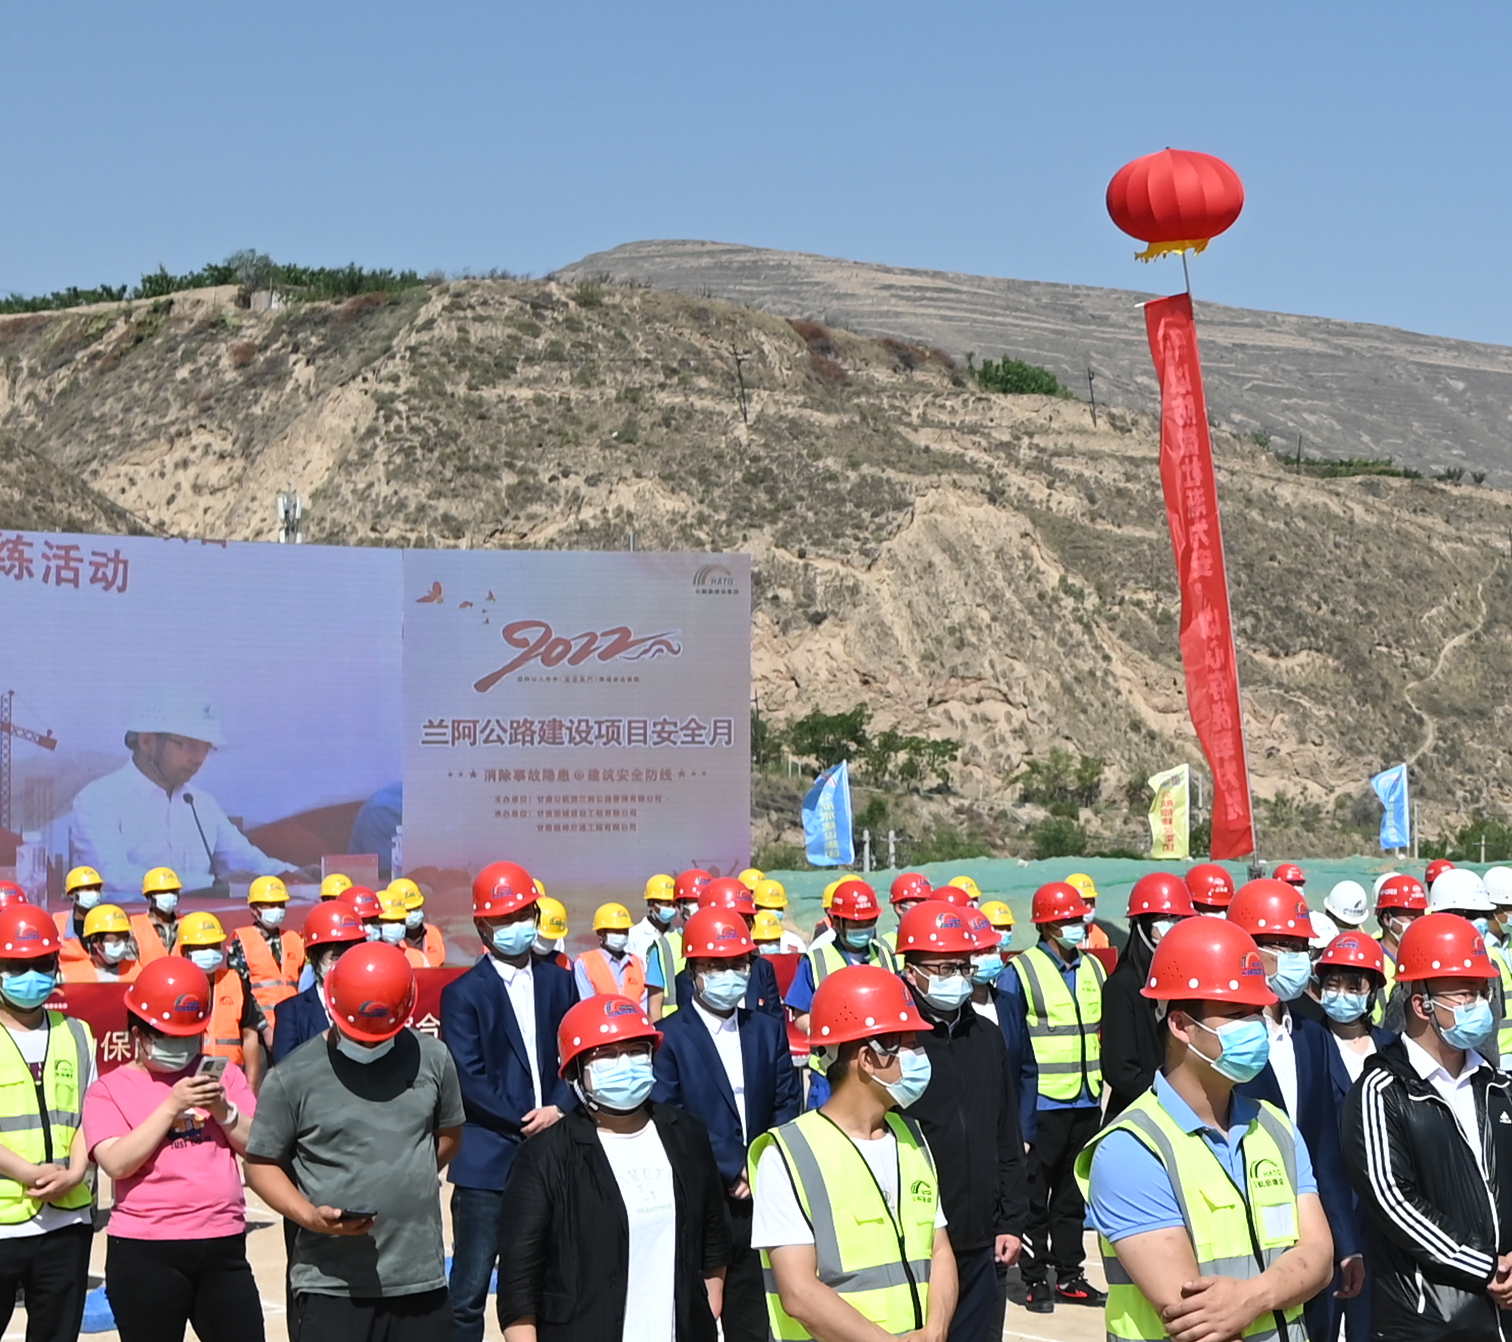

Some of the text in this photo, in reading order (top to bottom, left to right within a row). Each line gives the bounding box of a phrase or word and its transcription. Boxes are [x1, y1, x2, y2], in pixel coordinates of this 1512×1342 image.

[474, 620, 683, 693] 2022
[420, 716, 735, 748] 兰阿公路建设项目安全月
[484, 768, 673, 783] 消除事故隐患 建筑安全防线
